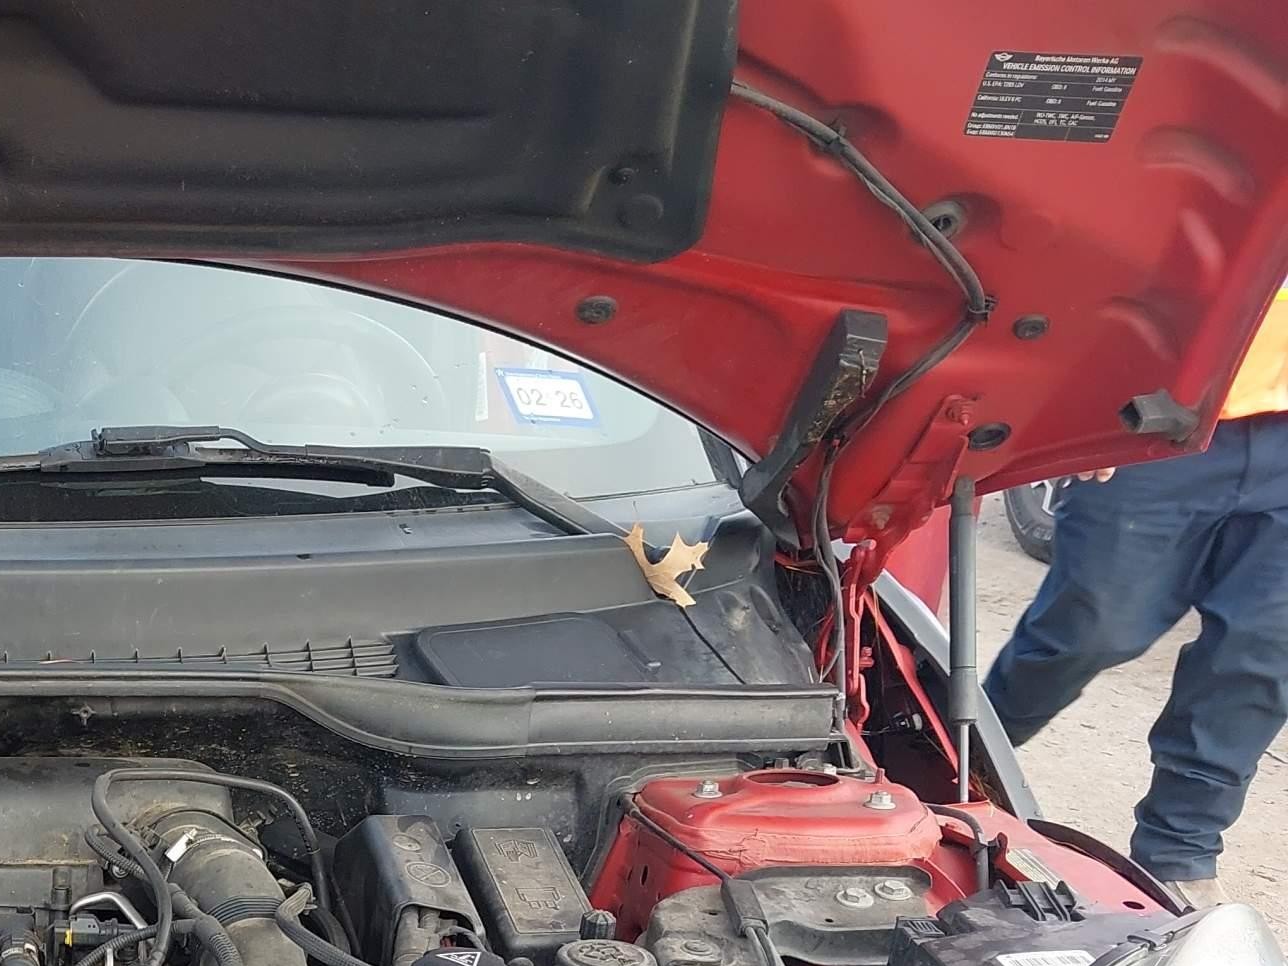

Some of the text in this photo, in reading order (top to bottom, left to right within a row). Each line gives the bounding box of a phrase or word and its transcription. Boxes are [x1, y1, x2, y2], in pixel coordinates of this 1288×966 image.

[1034, 54, 1066, 62] Bayerische
[1003, 62, 1137, 75] VEHICLE EMISSION CONTROL INFORMATION
[516, 387, 547, 406] 02
